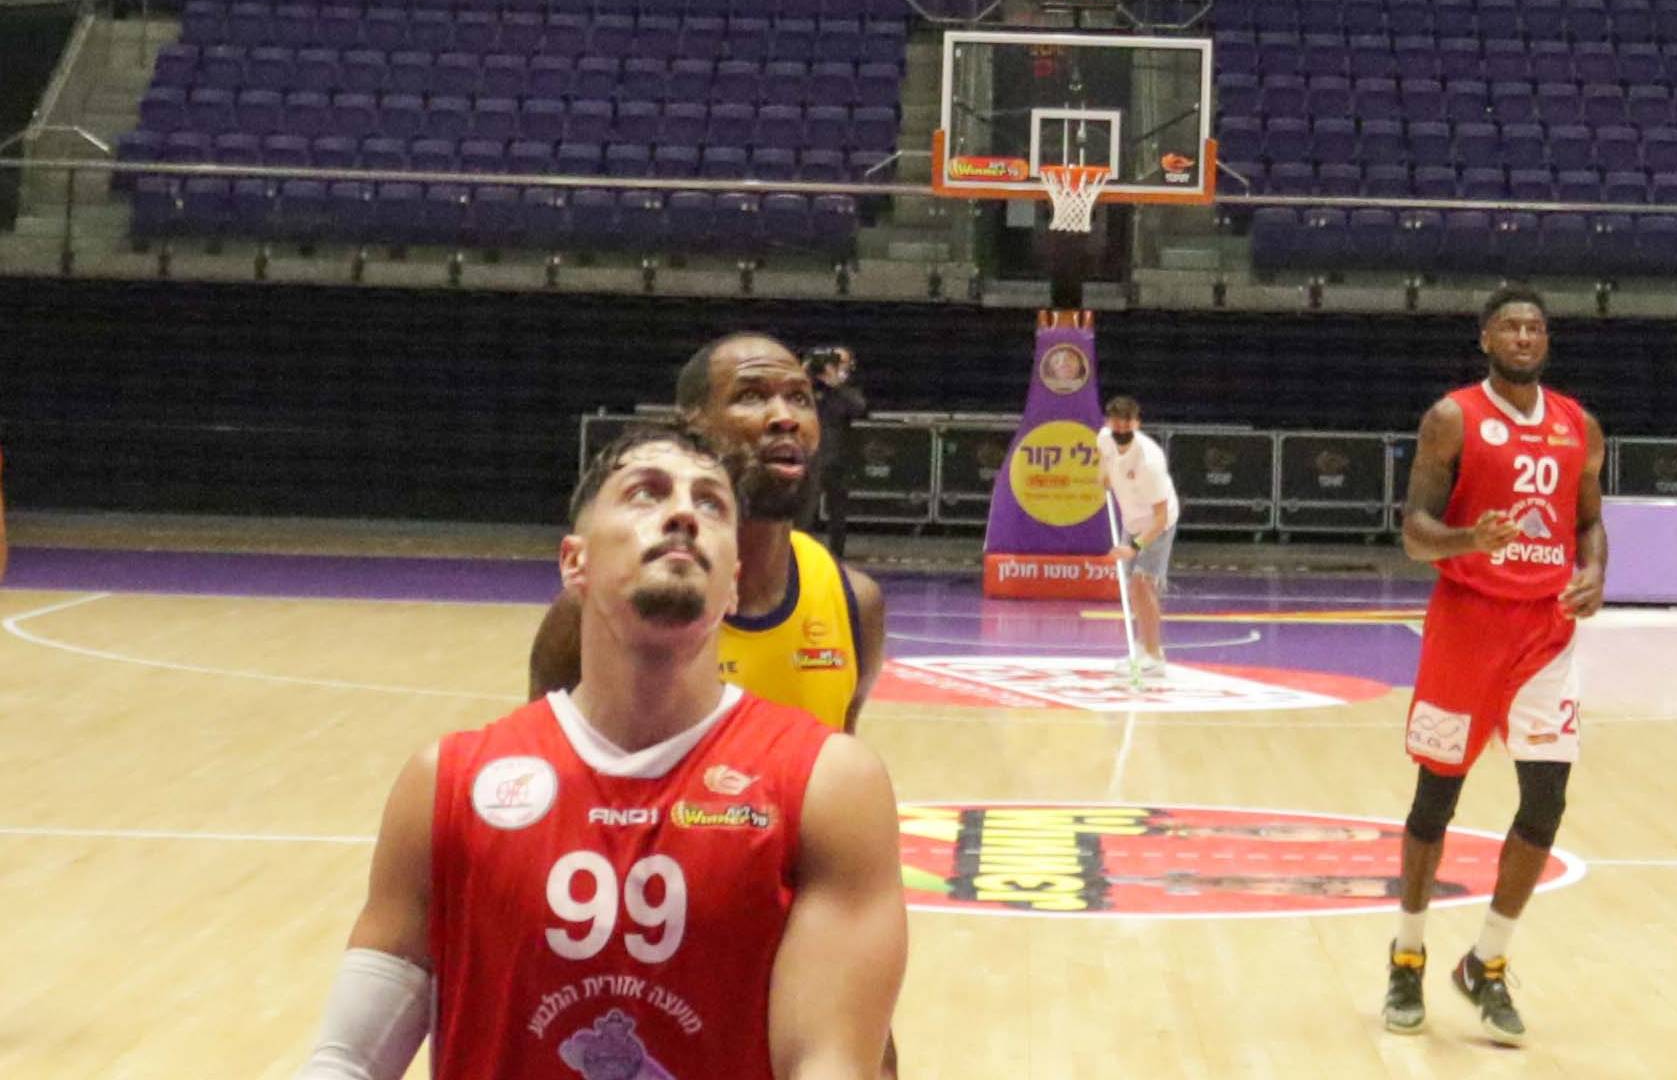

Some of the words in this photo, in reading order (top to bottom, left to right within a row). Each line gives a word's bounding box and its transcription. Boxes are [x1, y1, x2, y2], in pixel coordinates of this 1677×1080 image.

[1020, 445, 1062, 472] קור
[1070, 442, 1100, 466] לי
[1513, 454, 1559, 496] 20
[998, 560, 1039, 582] חולון
[1559, 699, 1577, 735] 2
[545, 851, 688, 964] 99
